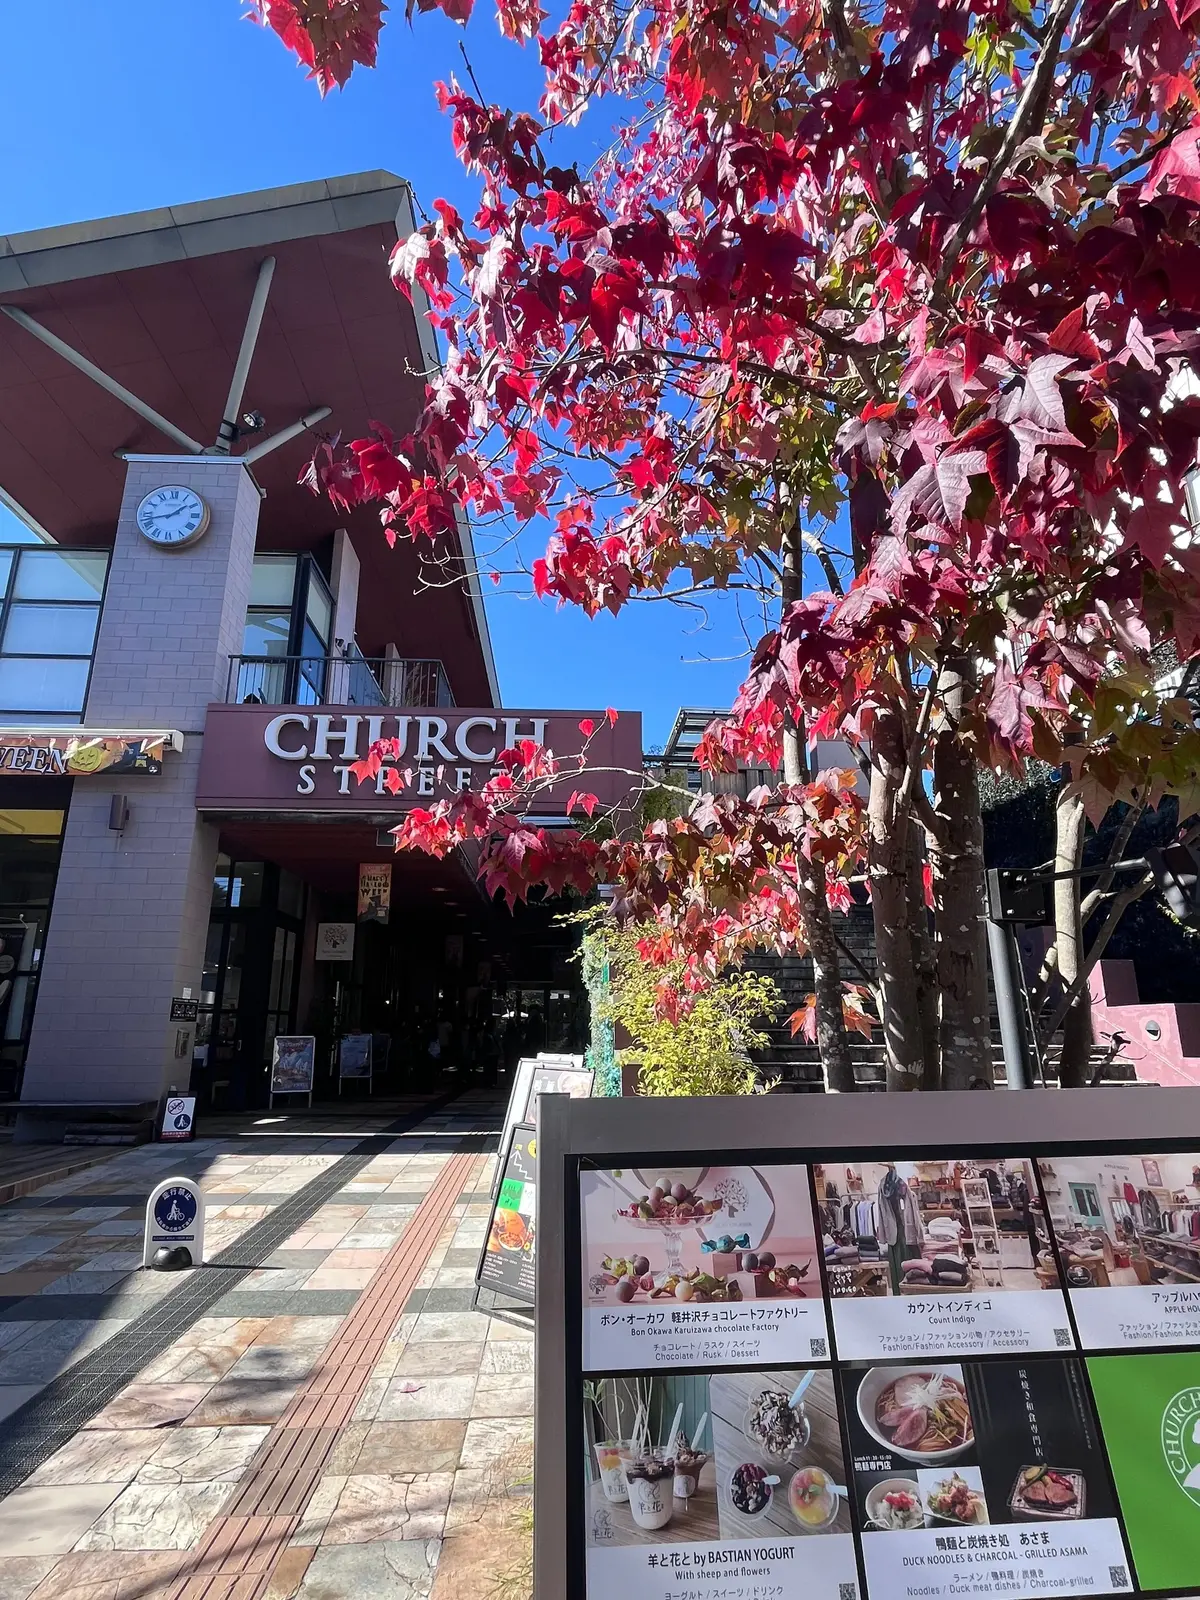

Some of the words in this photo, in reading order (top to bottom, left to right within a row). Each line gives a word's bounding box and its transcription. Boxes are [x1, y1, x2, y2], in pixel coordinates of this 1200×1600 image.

[264, 713, 550, 763] CHURCH
[1151, 1290, 1200, 1303] アップルハ
[907, 1299, 992, 1315] カウントインディゴ
[1164, 1305, 1186, 1314] APPLE
[671, 1307, 809, 1323] 軽井沢チョコレートファクトリー
[928, 1316, 951, 1325] Count
[952, 1314, 976, 1325] Indigo
[631, 1327, 646, 1336] Bon
[648, 1326, 673, 1336] Okawa
[674, 1324, 712, 1334] Karuizawa
[714, 1323, 750, 1333] chocolate
[752, 1323, 780, 1333] Factory
[1165, 1321, 1200, 1330] ファッショ
[878, 1333, 920, 1343] ファッション
[989, 1329, 1030, 1339] アクセサリー
[653, 1342, 696, 1352] チョコレート
[704, 1341, 724, 1350] ラスク
[732, 1339, 760, 1349] スイーツ
[947, 1340, 984, 1349] Accessory
[992, 1338, 1029, 1348] Accessory
[655, 1351, 694, 1361] Chocolate
[702, 1350, 722, 1359] Rusk
[731, 1349, 760, 1358] Dessert
[1019, 1532, 1050, 1546] あさま
[648, 1552, 691, 1568] 羊と花と
[693, 1552, 706, 1565] by
[708, 1549, 751, 1564] BASTIAN
[753, 1547, 796, 1561] YOGURT
[902, 1555, 926, 1567] DUCK
[927, 1553, 966, 1565] NOODLES
[967, 1553, 974, 1563] &
[975, 1551, 1019, 1563] CHARCOAL
[1024, 1549, 1058, 1560] GRILLED
[1060, 1547, 1088, 1557] ASAMA
[675, 1570, 695, 1580] With
[697, 1568, 721, 1580] sheep
[724, 1567, 739, 1577] and
[741, 1567, 771, 1577] flowers
[953, 1573, 984, 1583] ラーメン
[713, 1588, 744, 1598] スイーツ
[753, 1586, 784, 1597] ドリンク
[907, 1586, 940, 1596] Noodles
[950, 1583, 970, 1594] Duck
[973, 1583, 992, 1592] meat
[995, 1581, 1021, 1591] dishes
[1030, 1576, 1094, 1589] Charcoal-grilled
